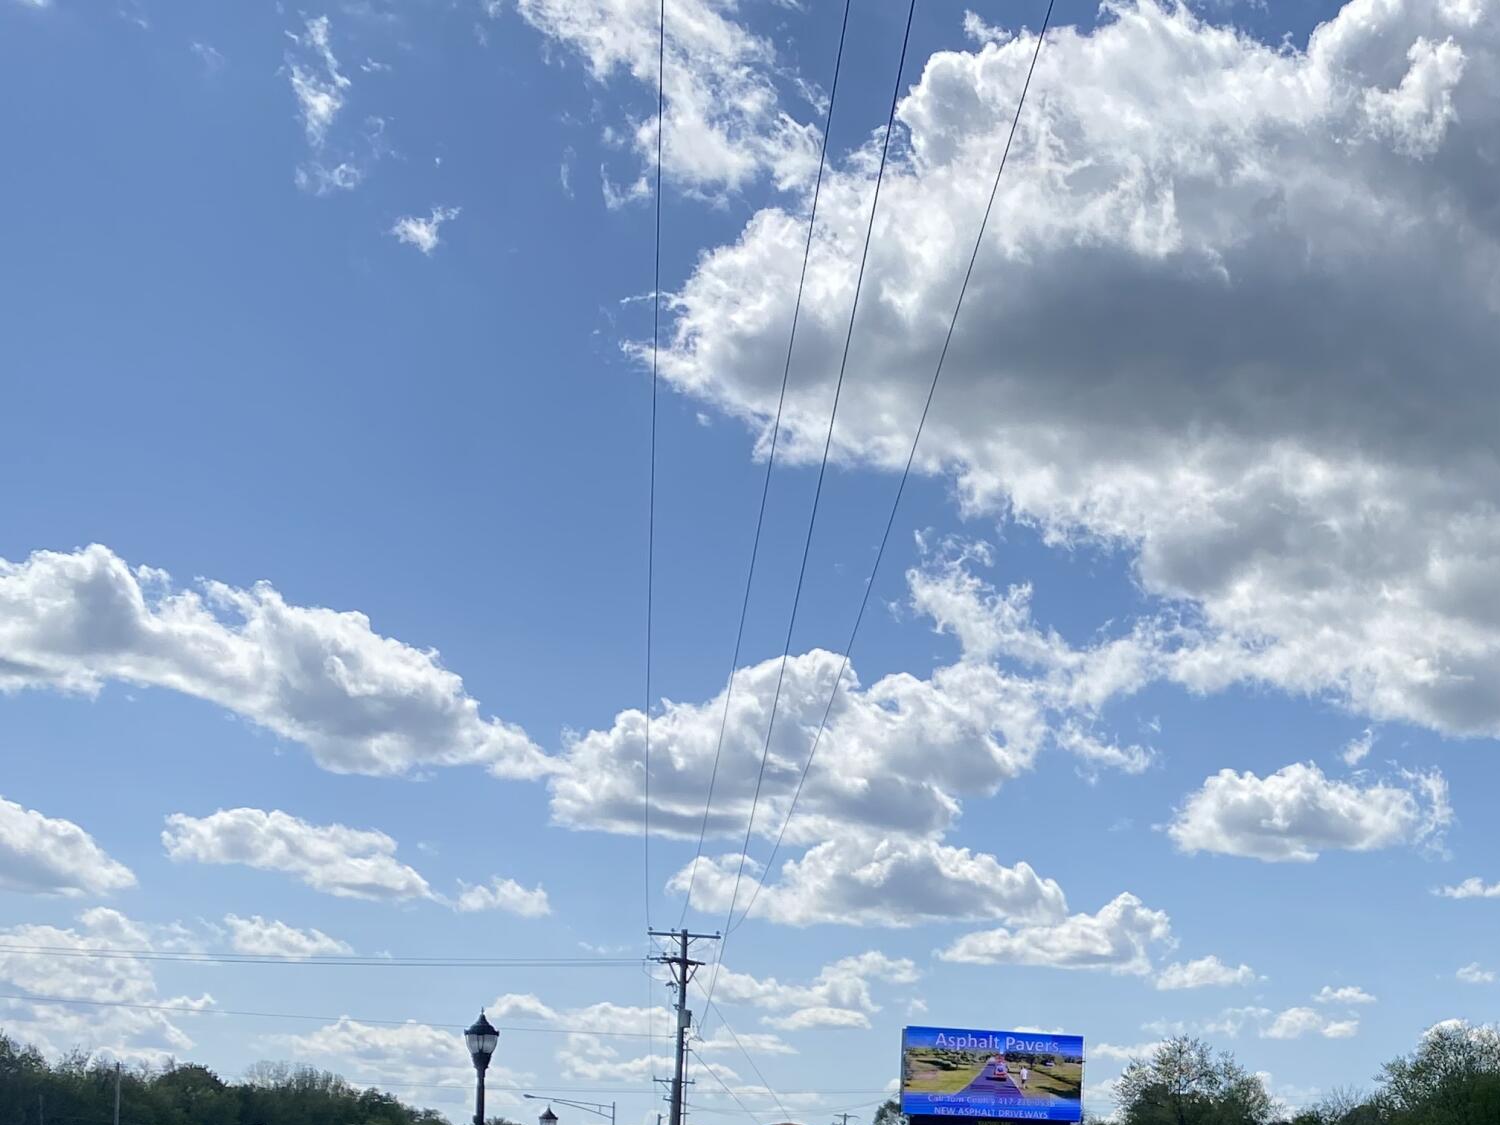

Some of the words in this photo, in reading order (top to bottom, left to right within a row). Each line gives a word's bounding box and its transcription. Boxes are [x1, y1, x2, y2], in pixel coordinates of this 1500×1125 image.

[935, 1032, 999, 1050] Asphalt
[1004, 1036, 1060, 1052] Pavers
[934, 1106, 956, 1115] NEW
[957, 1107, 996, 1117] ASPHALT
[998, 1109, 1049, 1119] DRIVEWAYS
